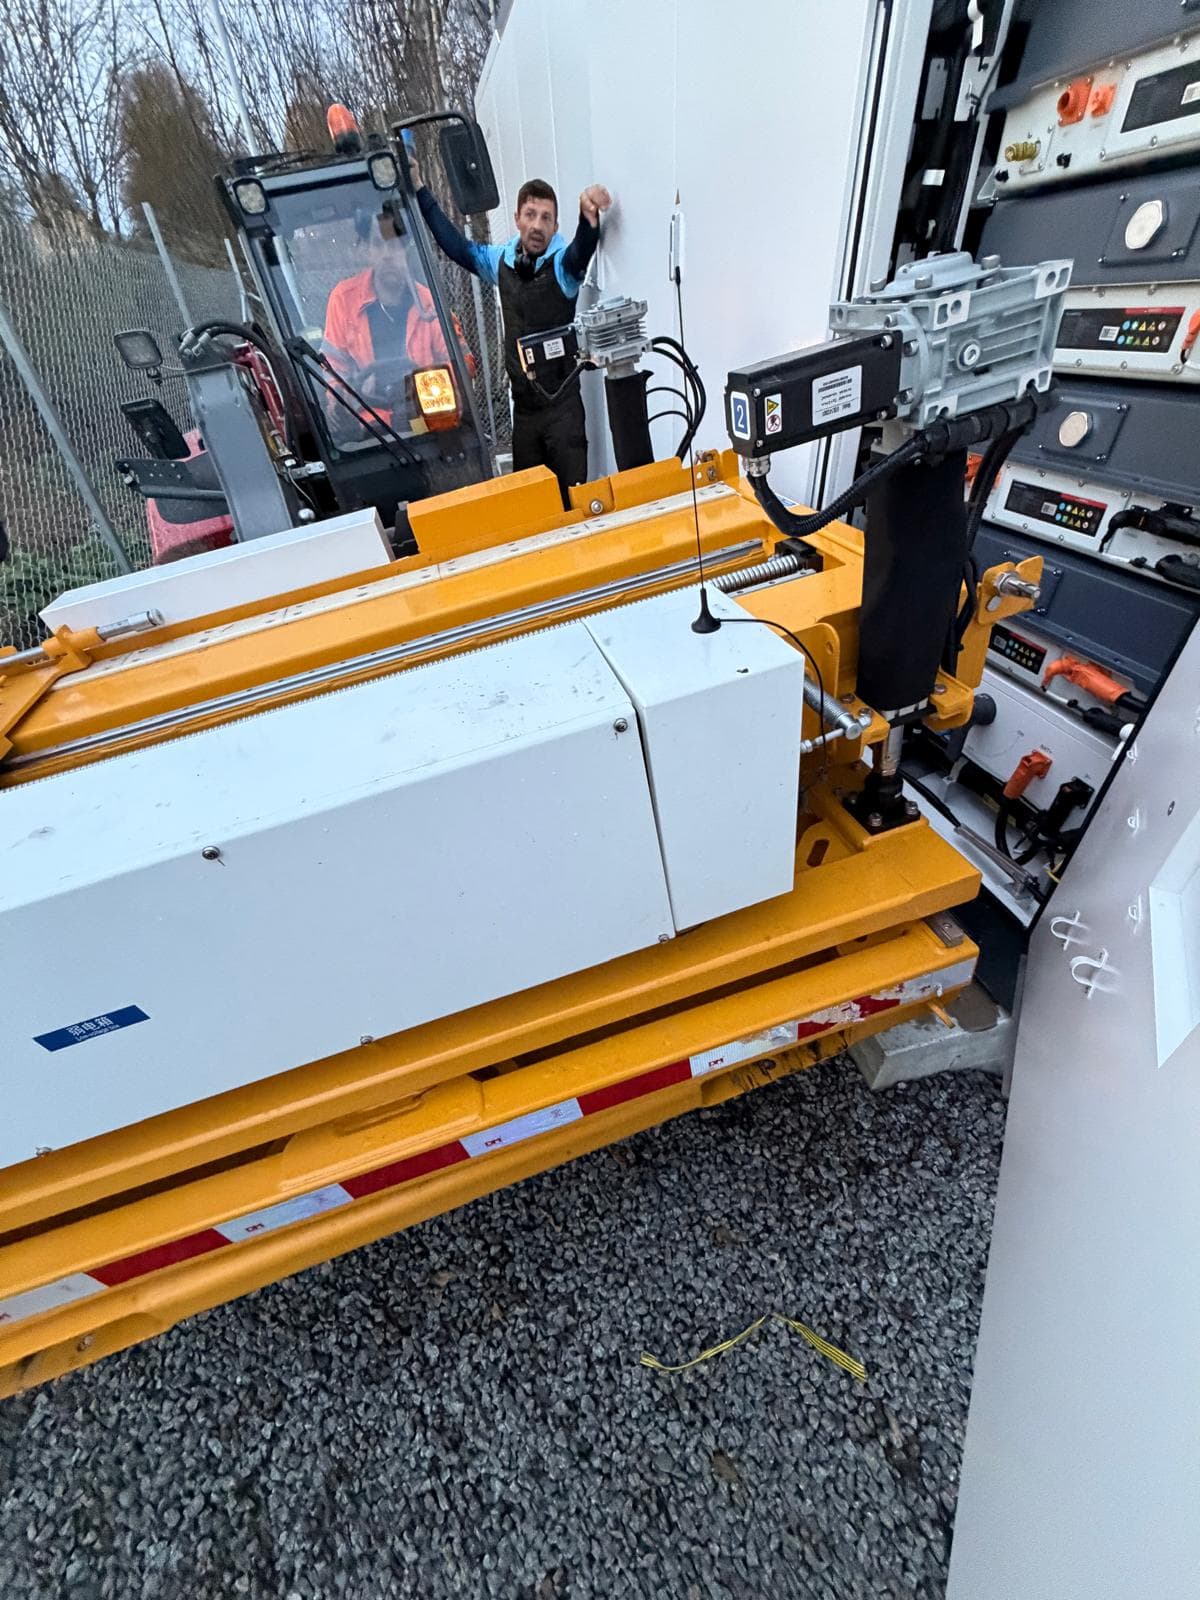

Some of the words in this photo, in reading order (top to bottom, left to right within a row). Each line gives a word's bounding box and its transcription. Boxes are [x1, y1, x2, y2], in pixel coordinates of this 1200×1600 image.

[736, 404, 745, 428] 2
[67, 1016, 114, 1036] 弱电箱
